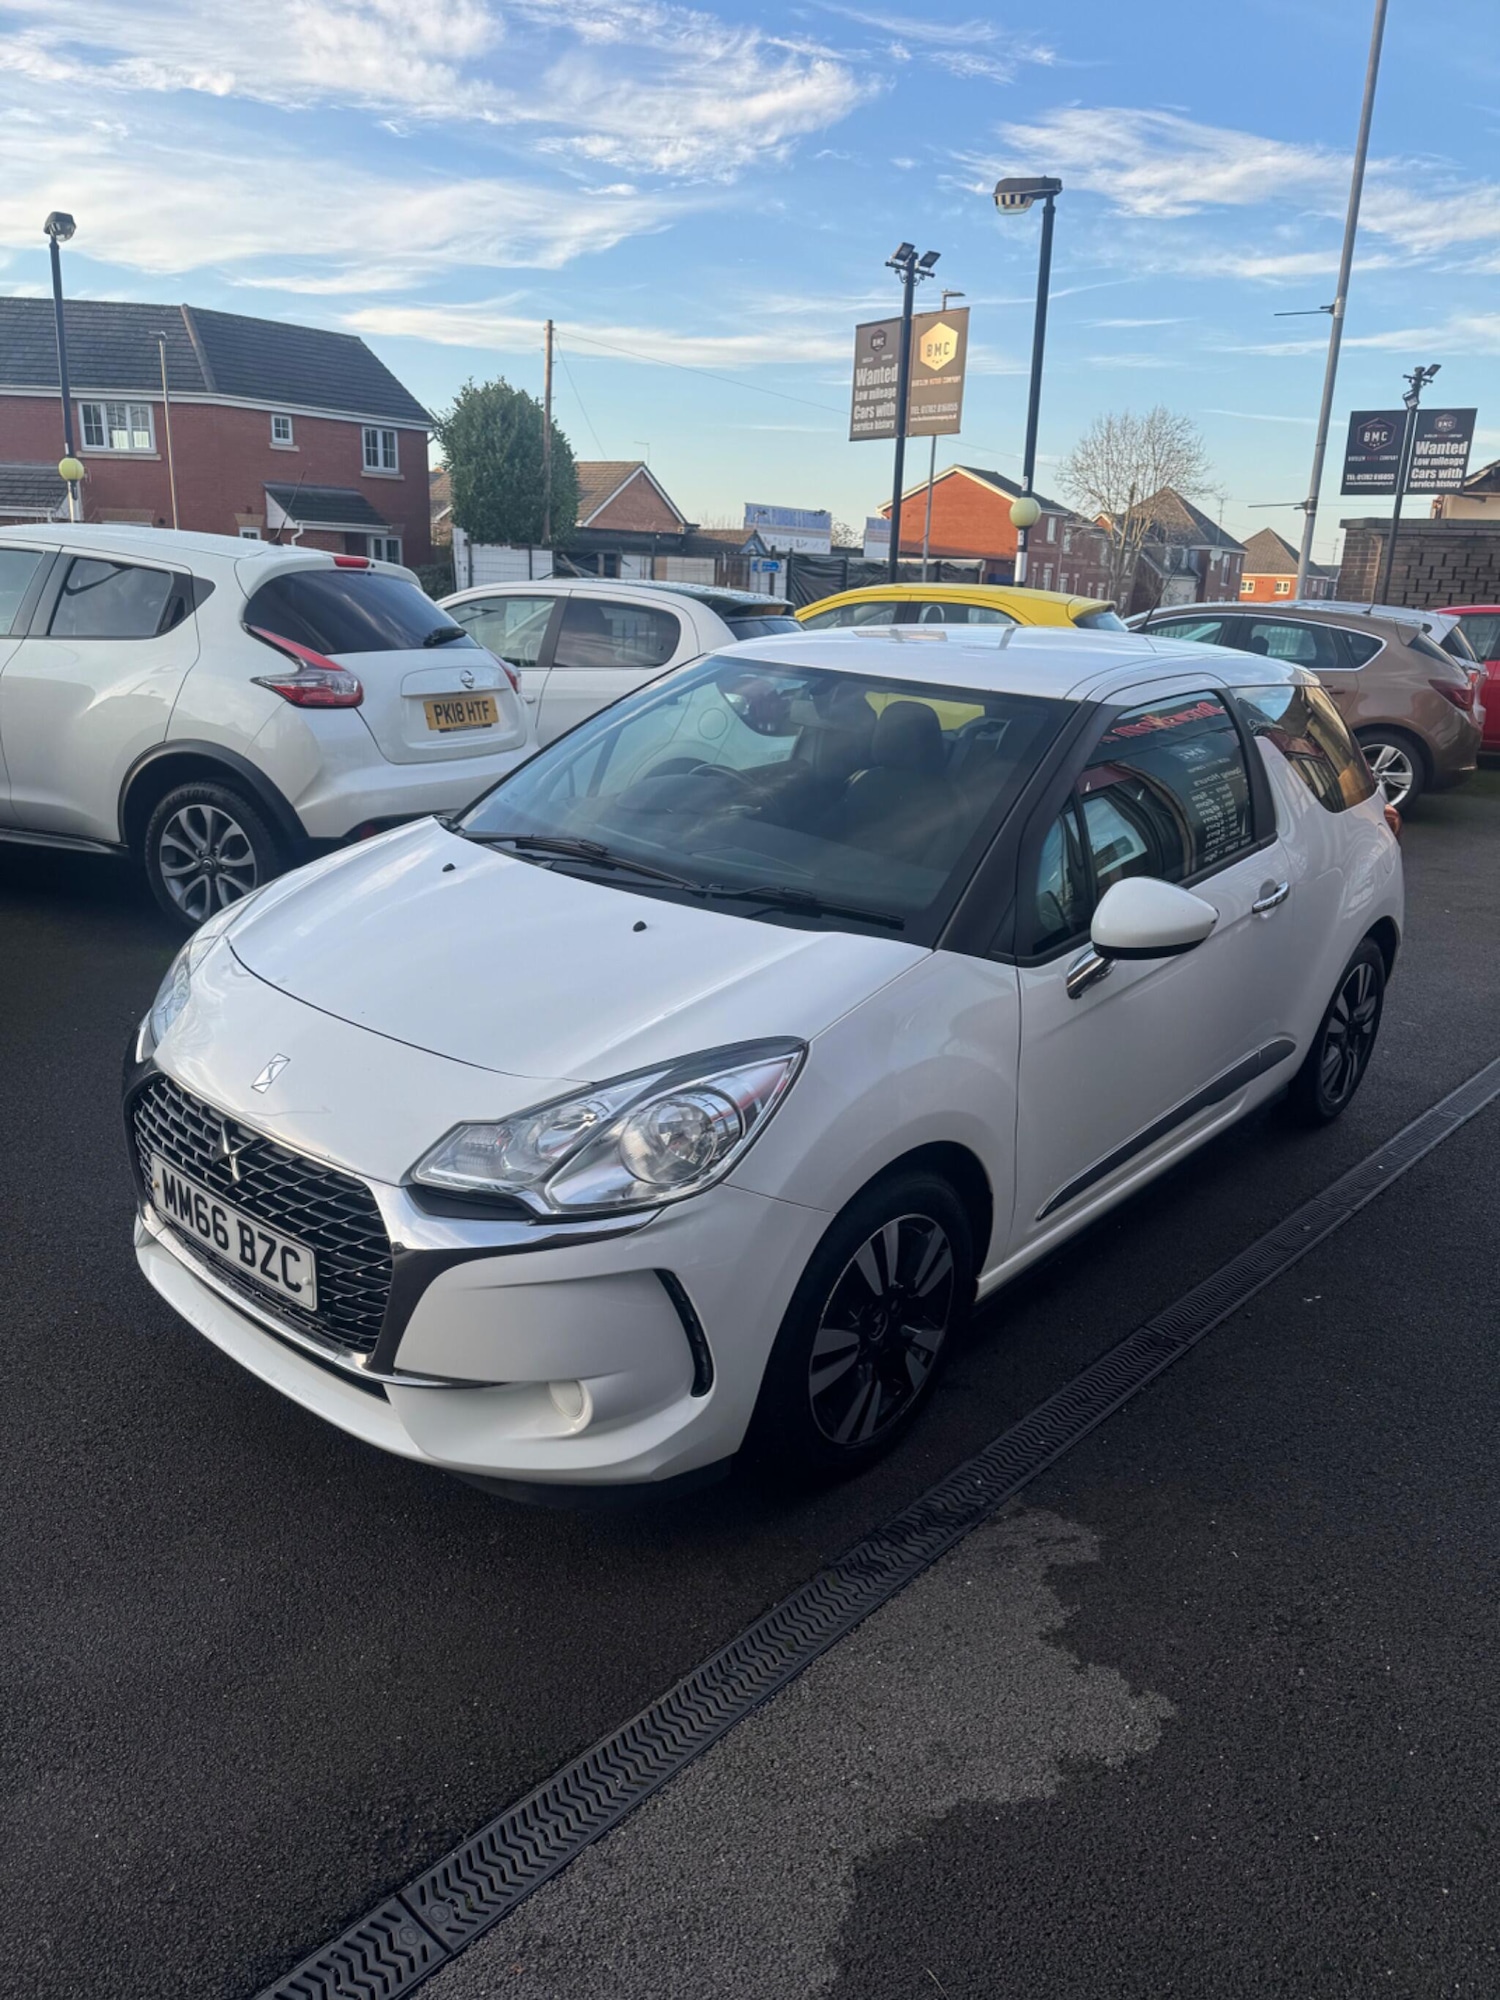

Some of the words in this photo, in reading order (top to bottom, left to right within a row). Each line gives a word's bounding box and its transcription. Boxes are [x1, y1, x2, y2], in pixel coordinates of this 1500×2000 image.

[927, 342, 950, 358] BMC
[856, 363, 899, 387] Wanted
[855, 390, 869, 401] Low
[869, 387, 897, 400] mileage
[854, 405, 875, 420] Cars
[876, 401, 896, 417] with
[852, 422, 874, 431] service
[875, 420, 895, 430] history
[1363, 431, 1388, 442] BMC
[1416, 441, 1469, 455] Wanted
[1413, 457, 1429, 466] Low
[1430, 457, 1464, 467] mileage
[1411, 468, 1437, 479] Cars
[1438, 467, 1463, 479] with
[1436, 480, 1461, 488] history
[434, 702, 465, 725] PK18
[466, 701, 489, 722] HTF
[161, 1167, 230, 1251] MM66
[236, 1219, 302, 1293] BZC
